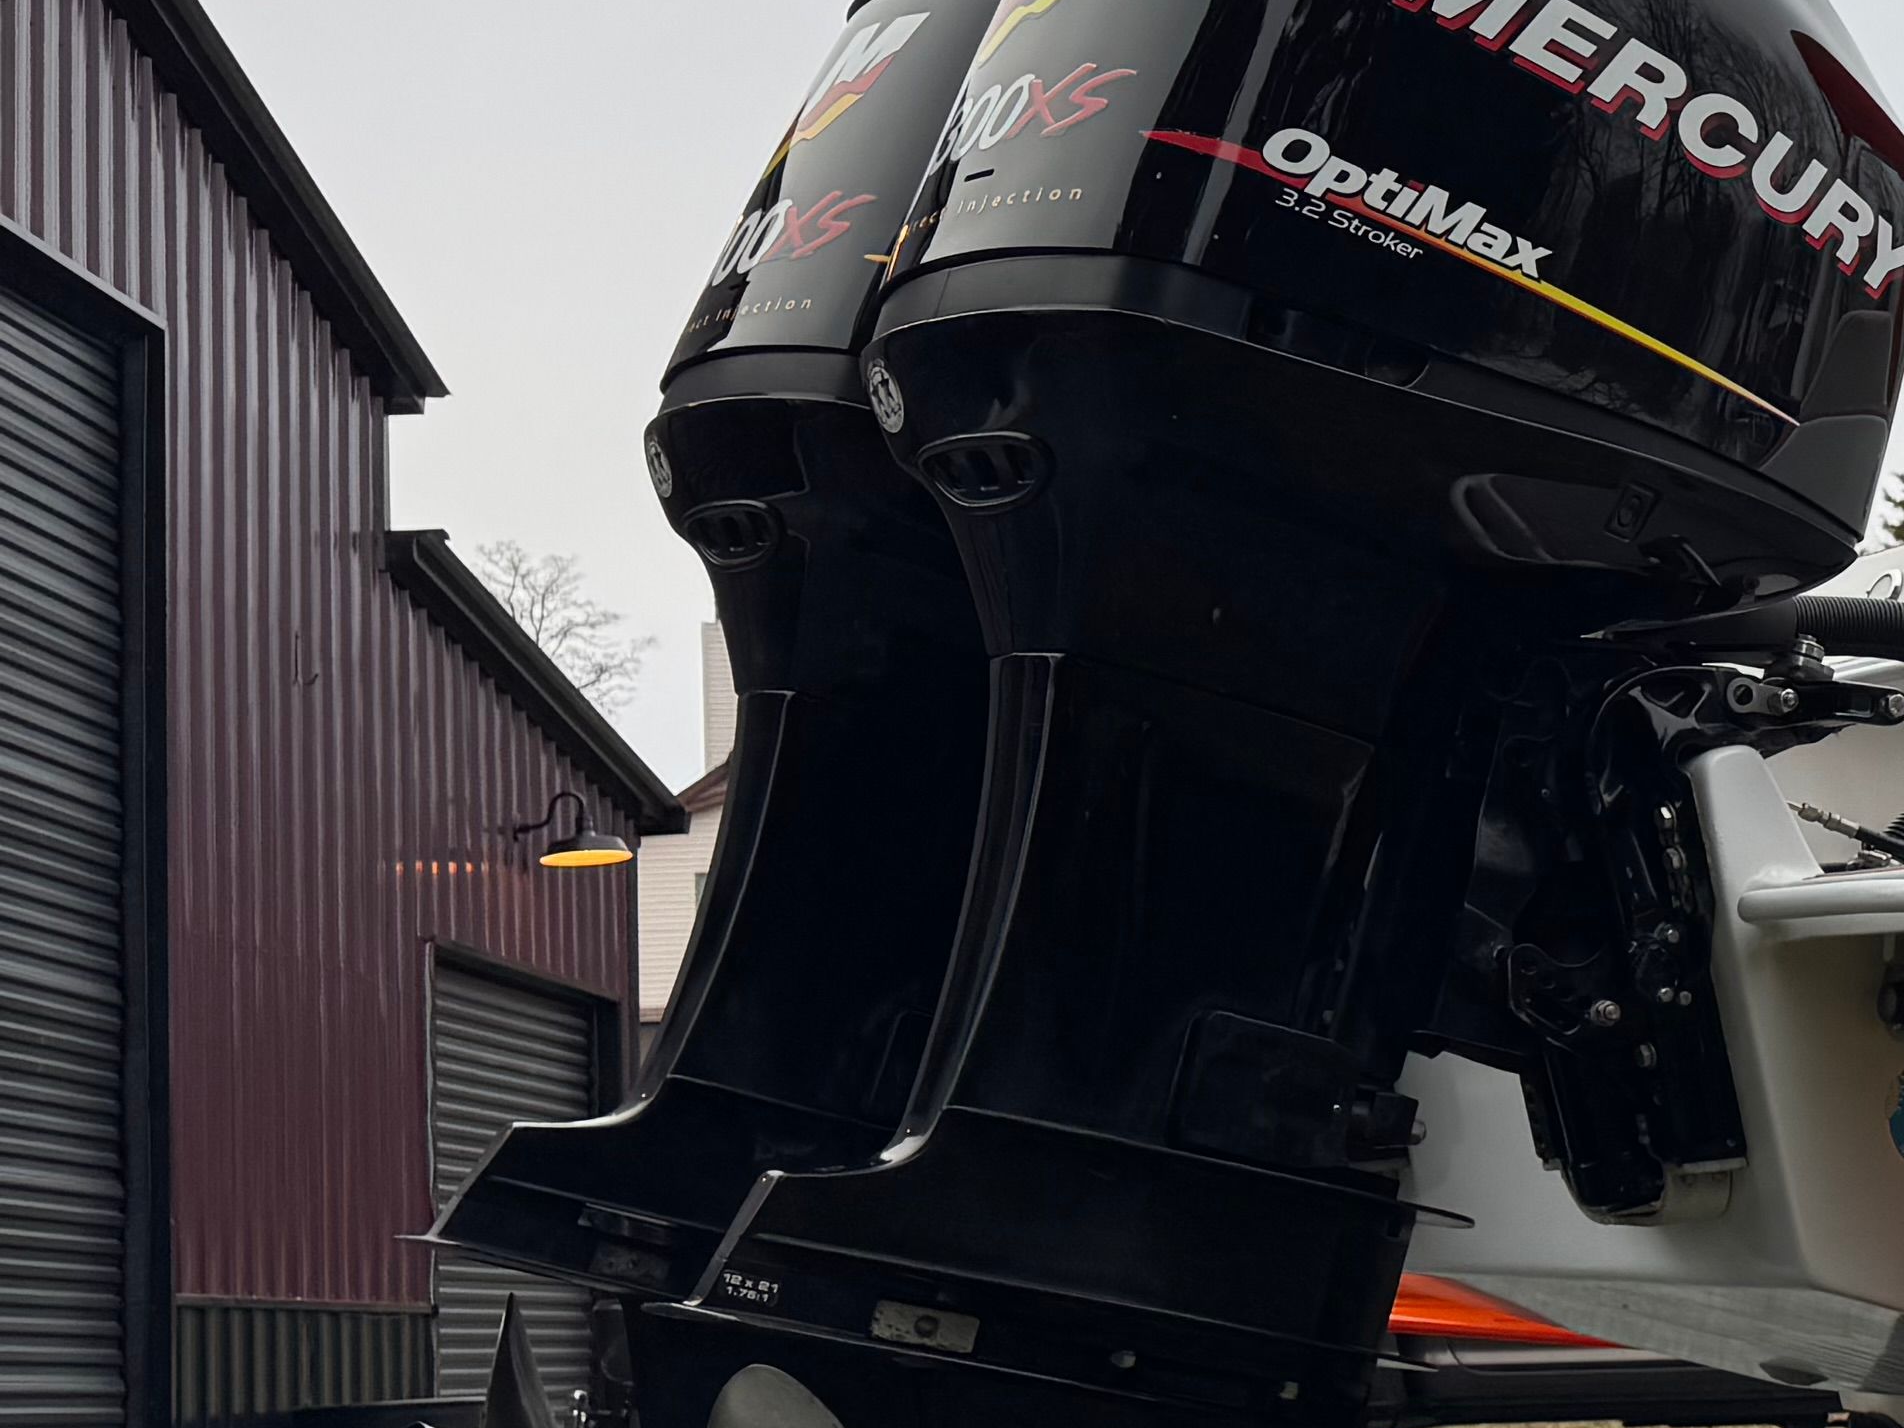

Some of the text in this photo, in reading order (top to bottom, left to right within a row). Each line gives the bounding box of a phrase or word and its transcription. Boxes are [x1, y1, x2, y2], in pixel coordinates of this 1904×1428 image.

[712, 190, 878, 287] 00XS
[1262, 128, 1552, 278] OptiMax
[1275, 188, 1423, 259] 3.2 Stroker
